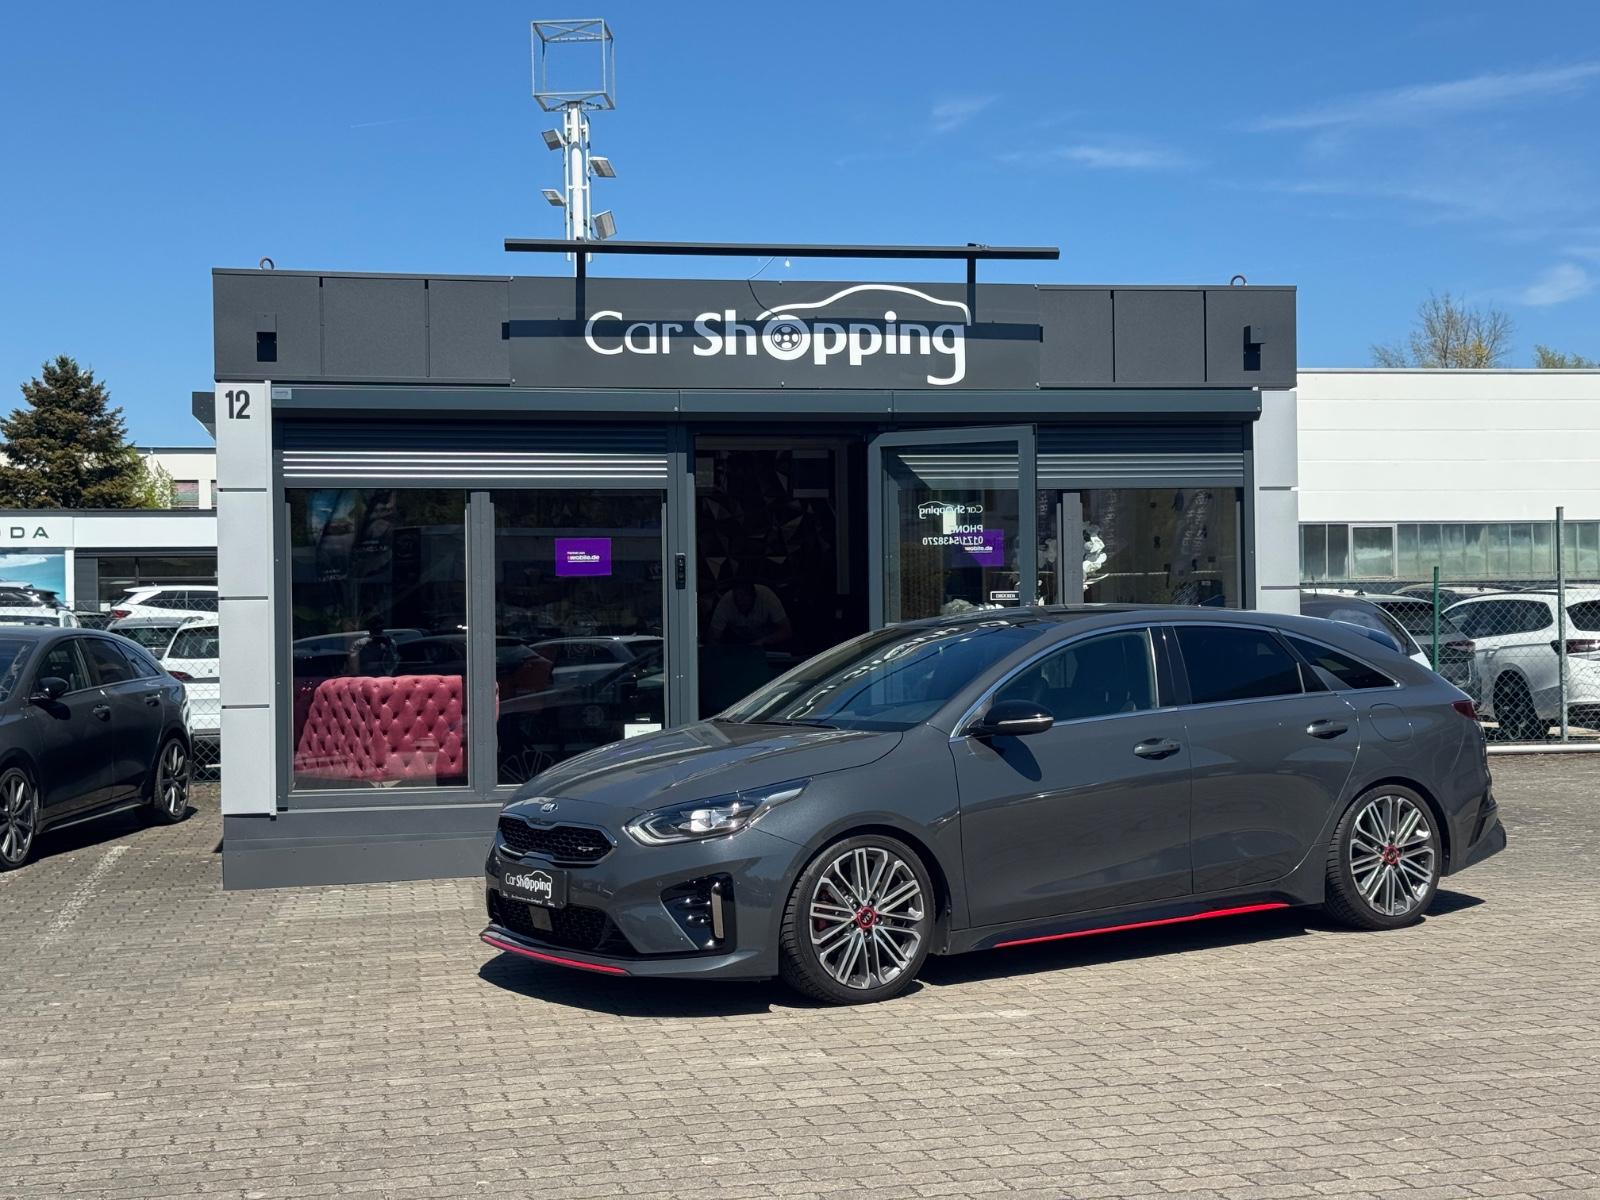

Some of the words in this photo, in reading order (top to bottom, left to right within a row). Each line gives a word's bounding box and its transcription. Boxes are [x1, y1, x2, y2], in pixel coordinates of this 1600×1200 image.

[584, 310, 684, 356] Car
[692, 308, 967, 386] Shopping
[225, 389, 251, 419] 12
[0, 526, 50, 539] DA
[505, 872, 517, 886] Car
[516, 873, 552, 900] Shopping
